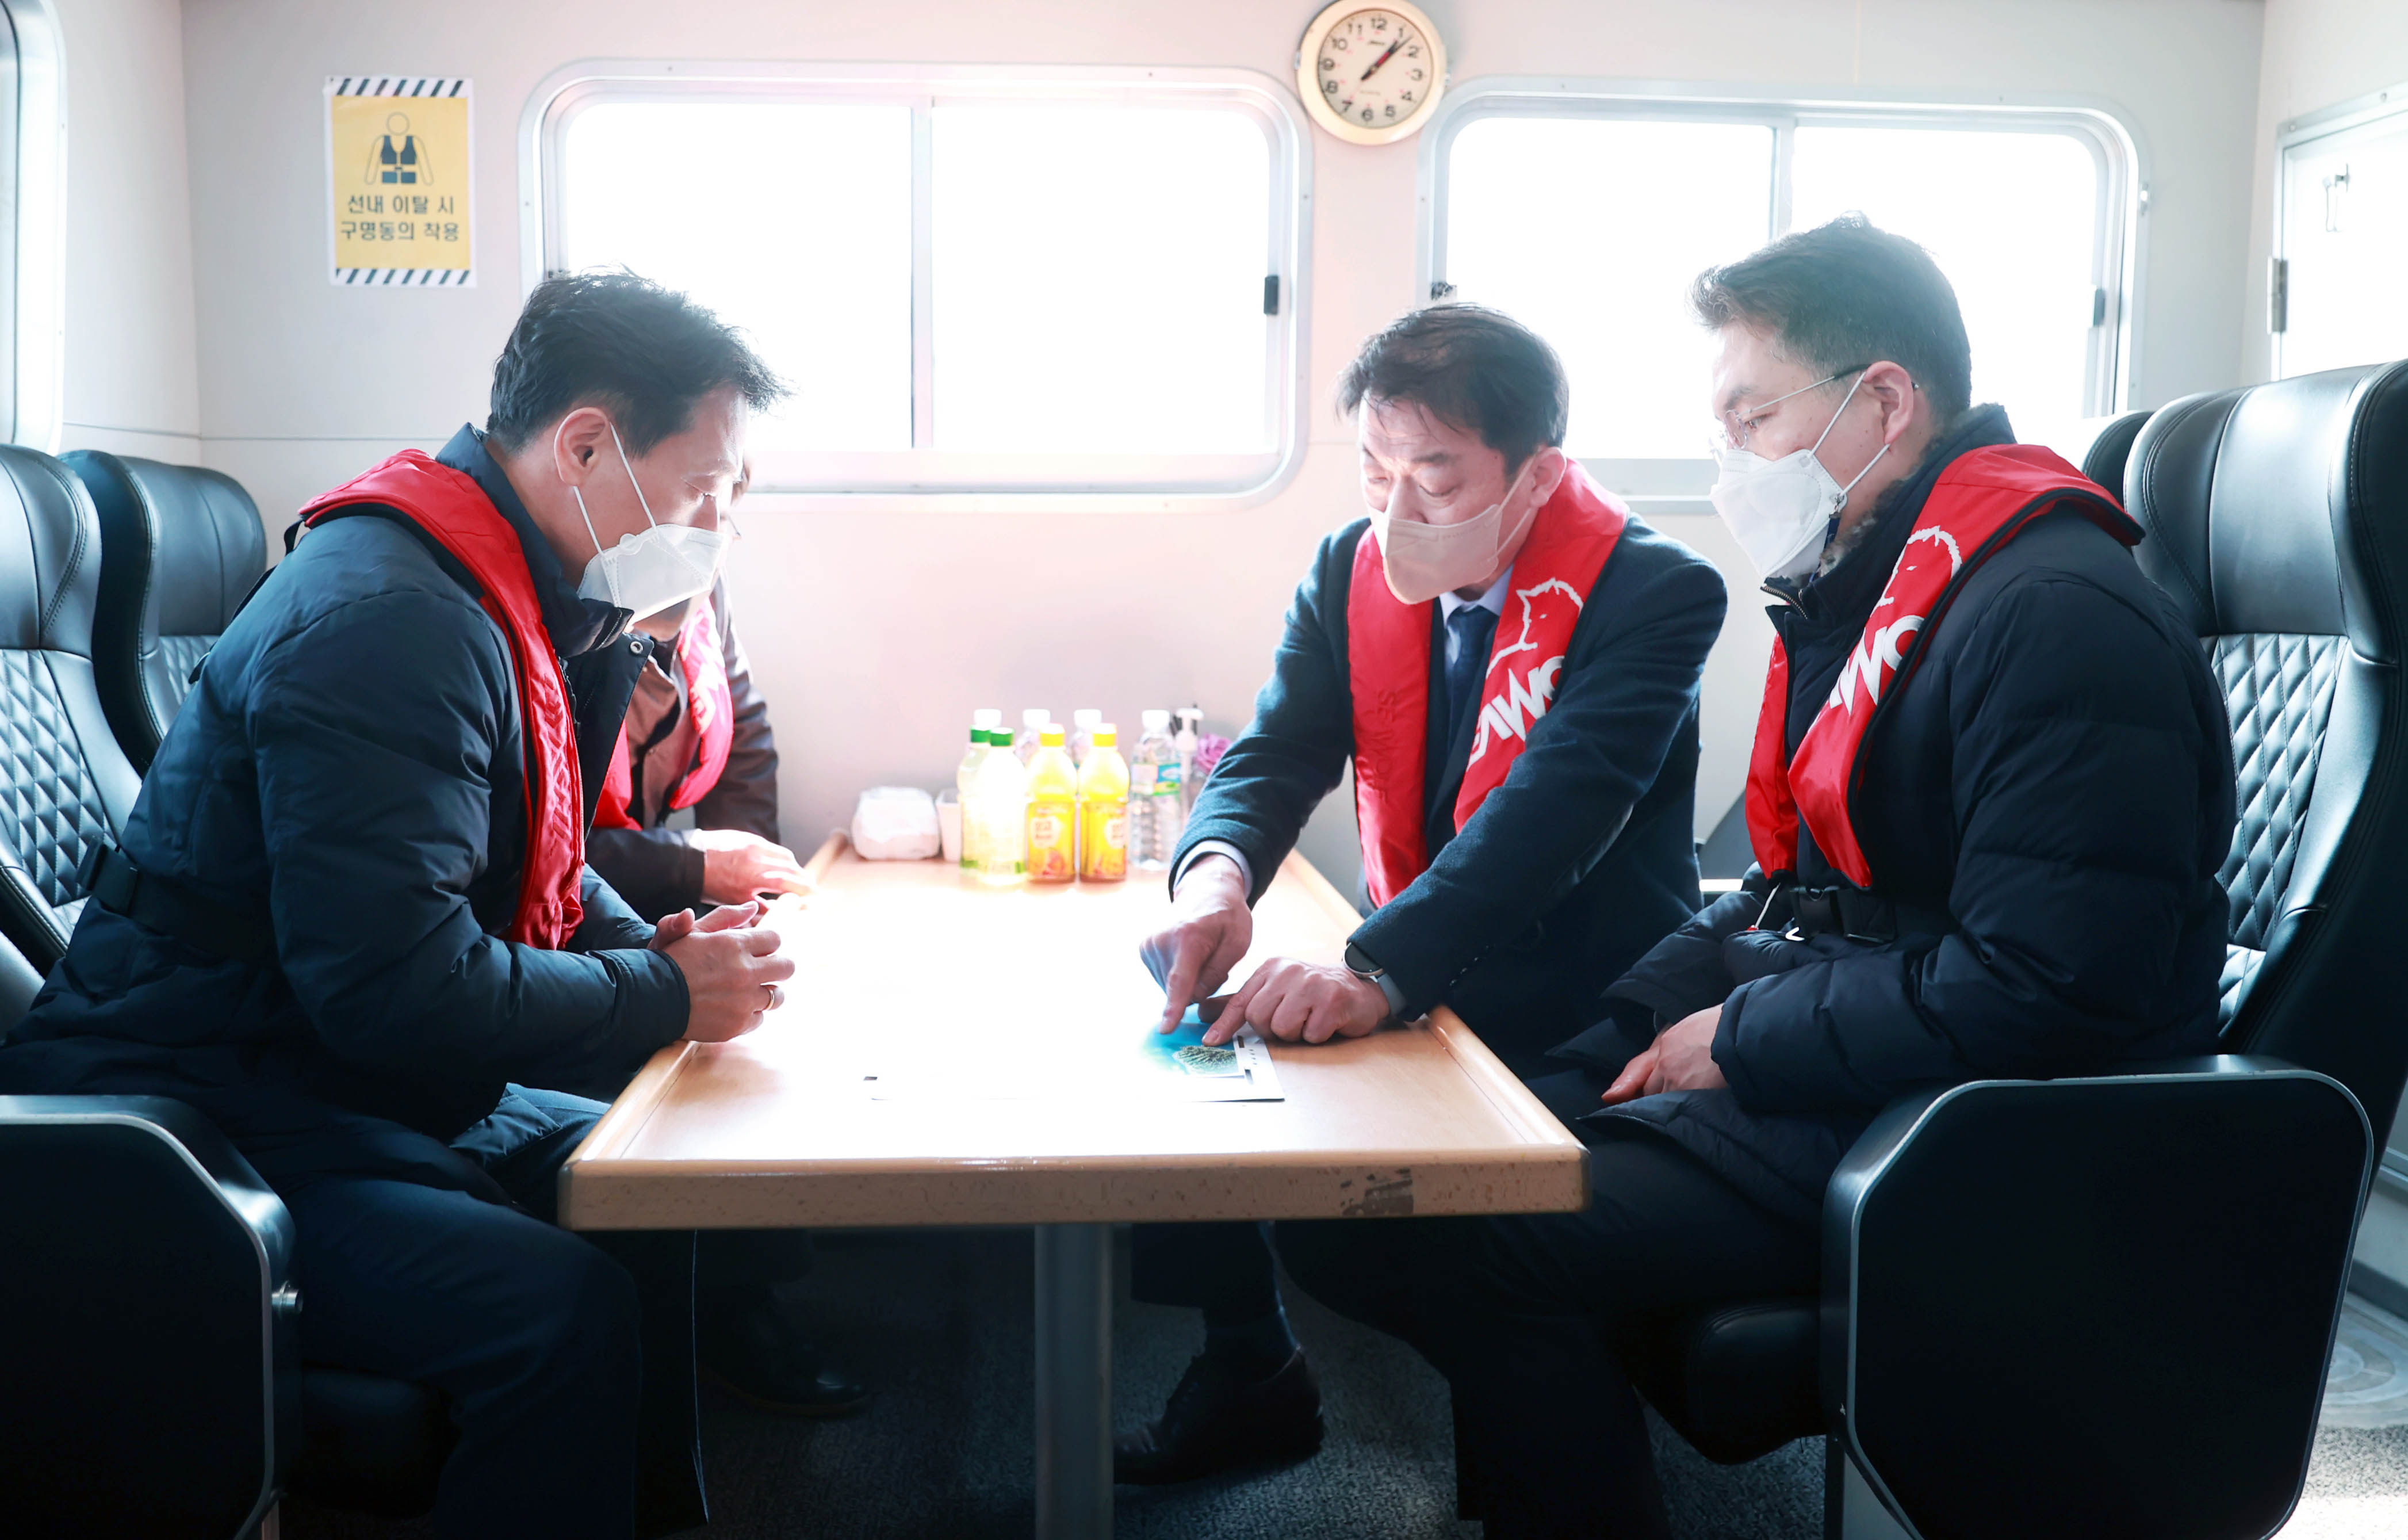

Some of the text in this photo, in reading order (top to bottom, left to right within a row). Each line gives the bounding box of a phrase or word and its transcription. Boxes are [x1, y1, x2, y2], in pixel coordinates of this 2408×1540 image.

[1348, 23, 1362, 35] 11
[1371, 18, 1388, 30] 12
[1332, 38, 1347, 51] 10
[1408, 45, 1419, 58] 2
[1323, 58, 1335, 71] 9
[1411, 68, 1423, 81] 3
[1326, 81, 1338, 94] 8
[1401, 91, 1412, 101] 4
[1342, 100, 1353, 112] 7
[1385, 105, 1396, 117] 5
[1361, 109, 1373, 122] 6
[349, 194, 453, 214] 선내 이탈 시
[340, 221, 458, 242] 구명동의 착용
